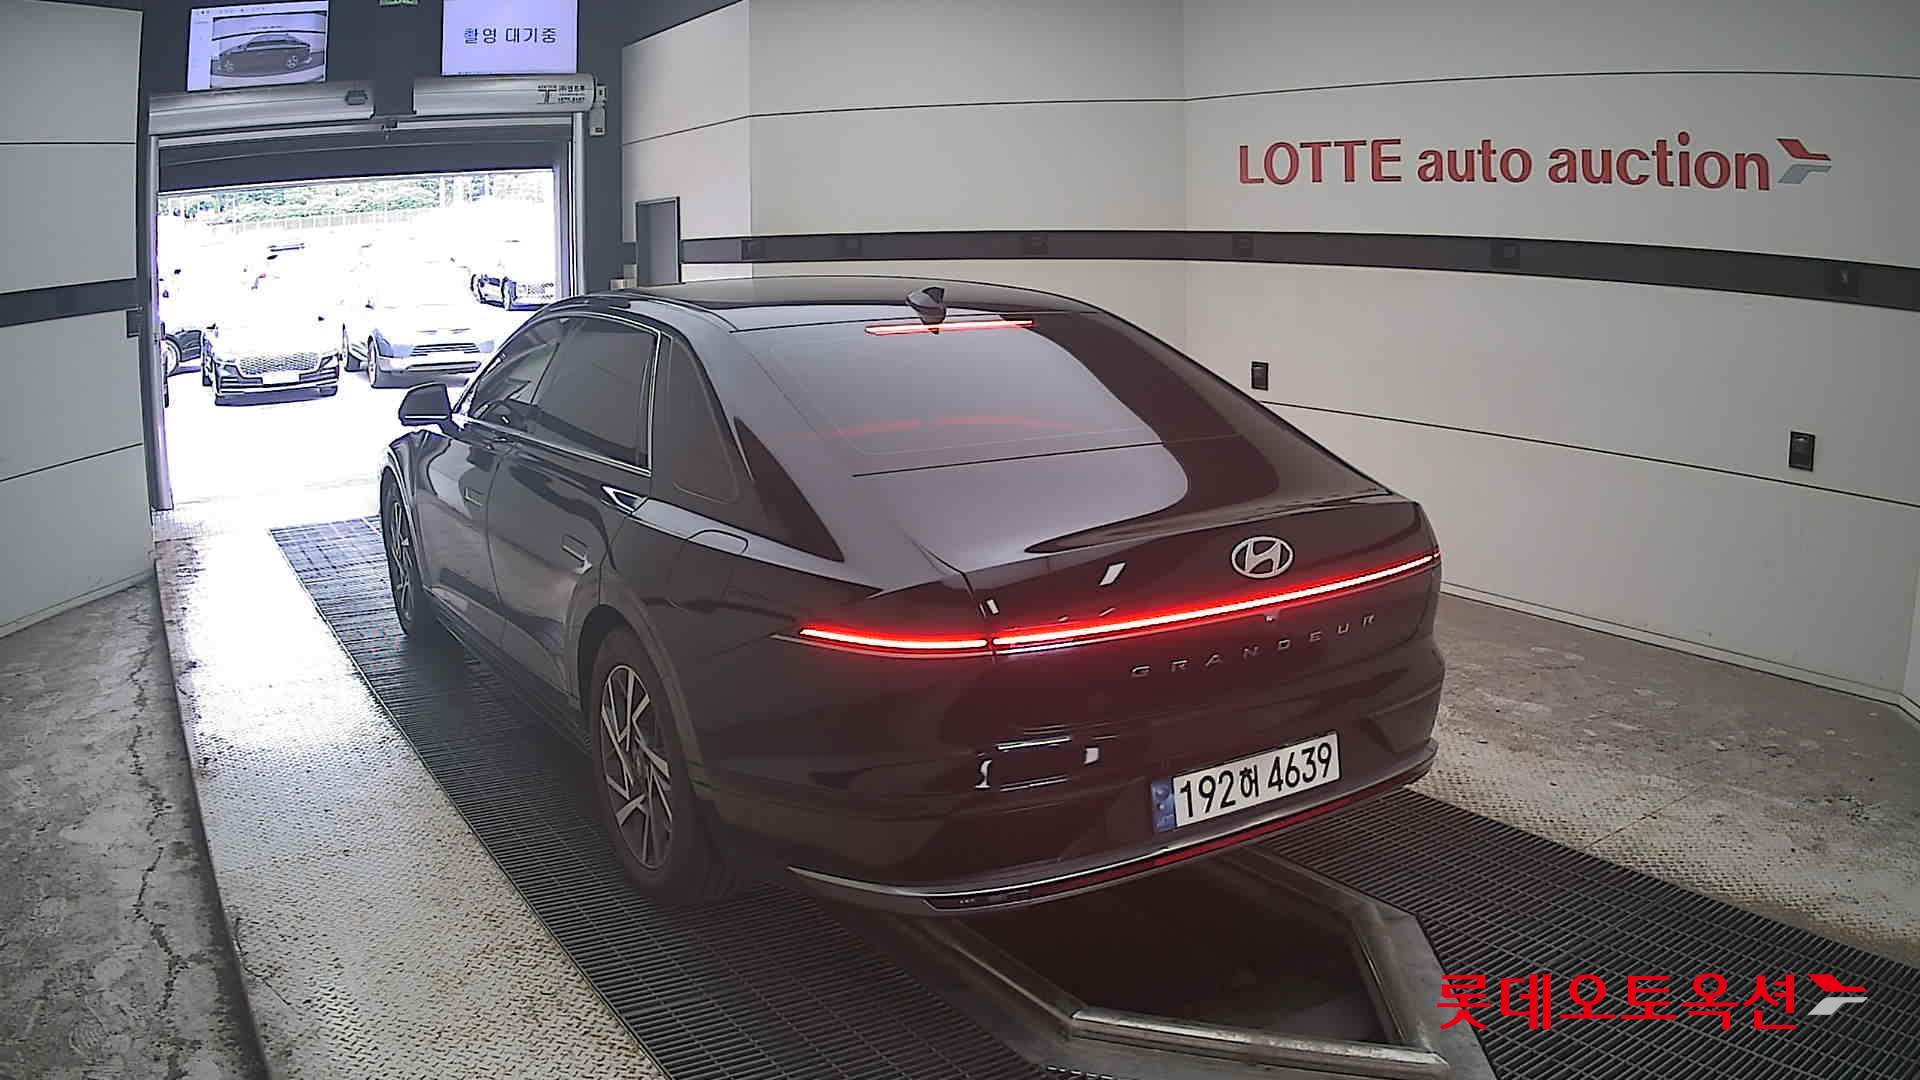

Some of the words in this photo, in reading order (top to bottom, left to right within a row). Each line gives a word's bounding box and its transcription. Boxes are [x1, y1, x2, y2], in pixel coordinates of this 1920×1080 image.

[464, 27, 497, 44] 촬영
[505, 27, 557, 44] 대기중
[1238, 138, 1402, 186] LOTTE
[1417, 138, 1533, 184] auto
[1547, 131, 1771, 191] auction
[1131, 612, 1376, 678] GRANDEUR
[1179, 763, 1260, 818] 192허
[1267, 742, 1332, 792] 4639
